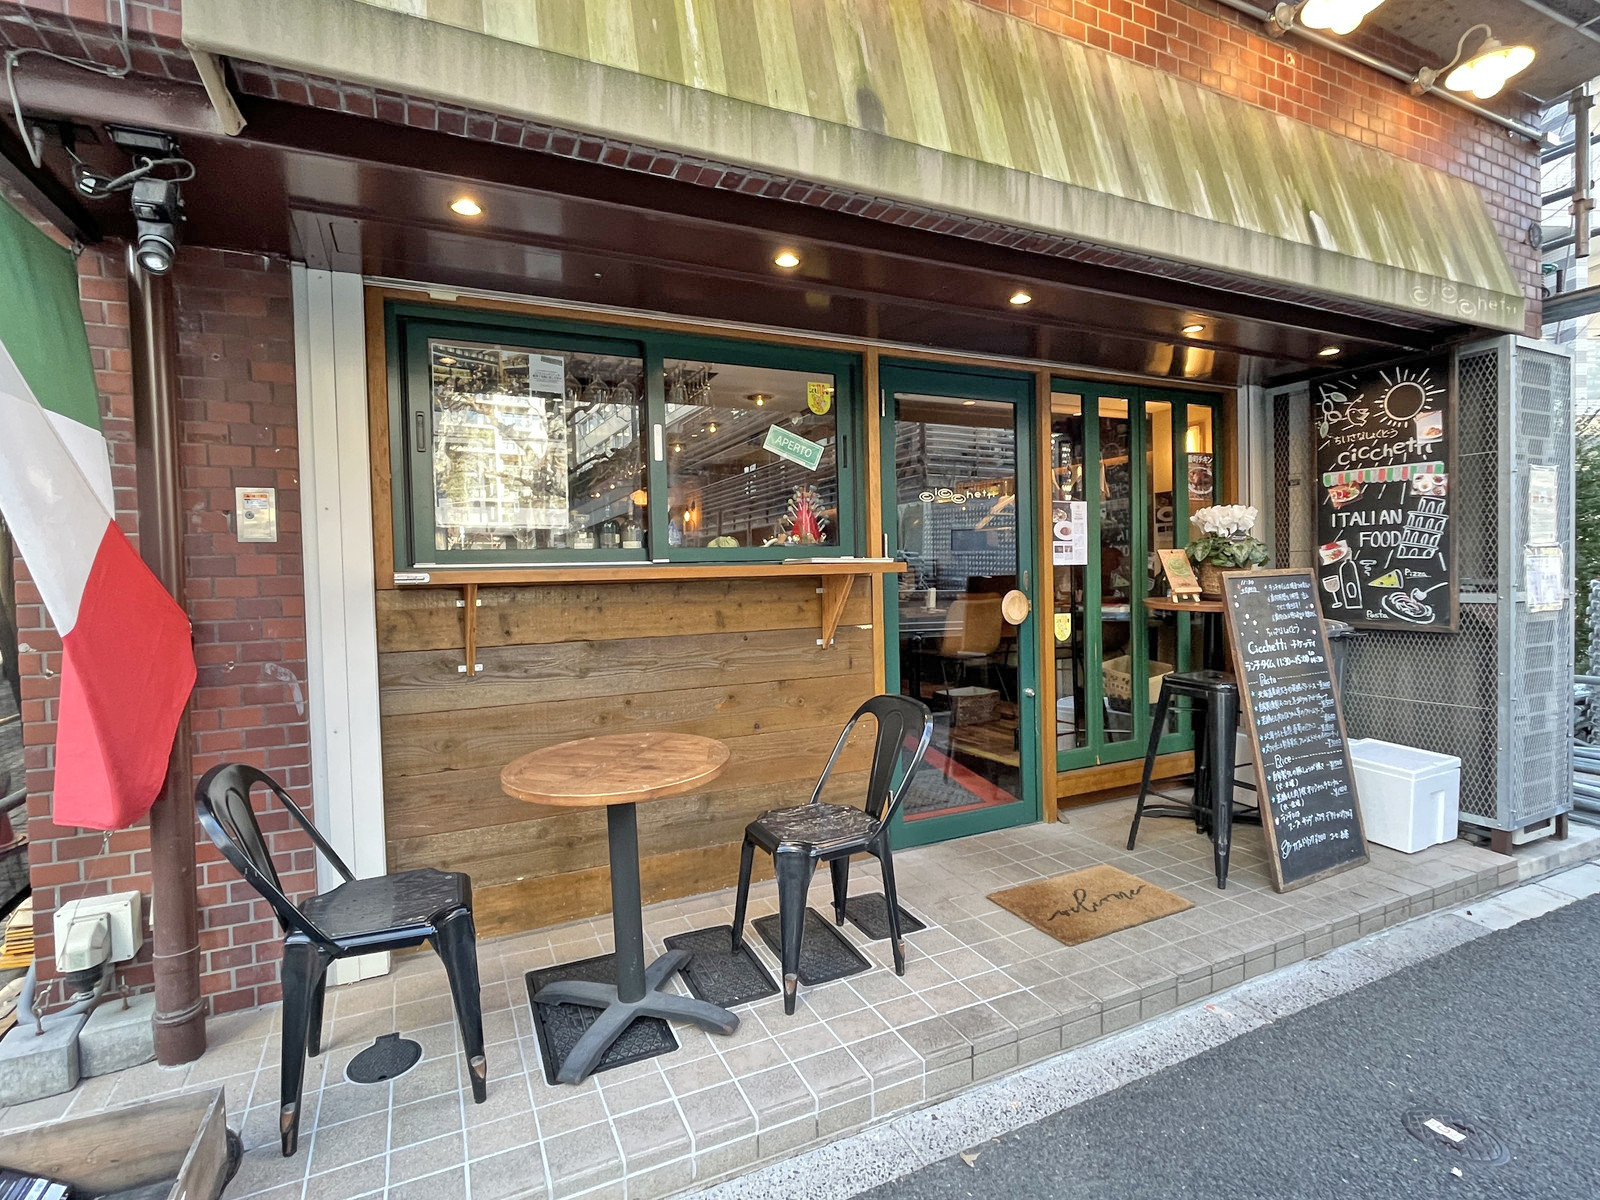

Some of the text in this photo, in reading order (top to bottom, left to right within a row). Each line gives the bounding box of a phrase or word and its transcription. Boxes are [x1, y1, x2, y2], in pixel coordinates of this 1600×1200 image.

[775, 436, 812, 457] APERTO
[1332, 509, 1402, 527] ITALIAN
[1360, 531, 1401, 547] FOOD
[1404, 568, 1427, 577] Pizza
[1366, 609, 1389, 619] Pasta
[1248, 638, 1287, 654] Cicchetti
[1259, 673, 1277, 687] Pasta
